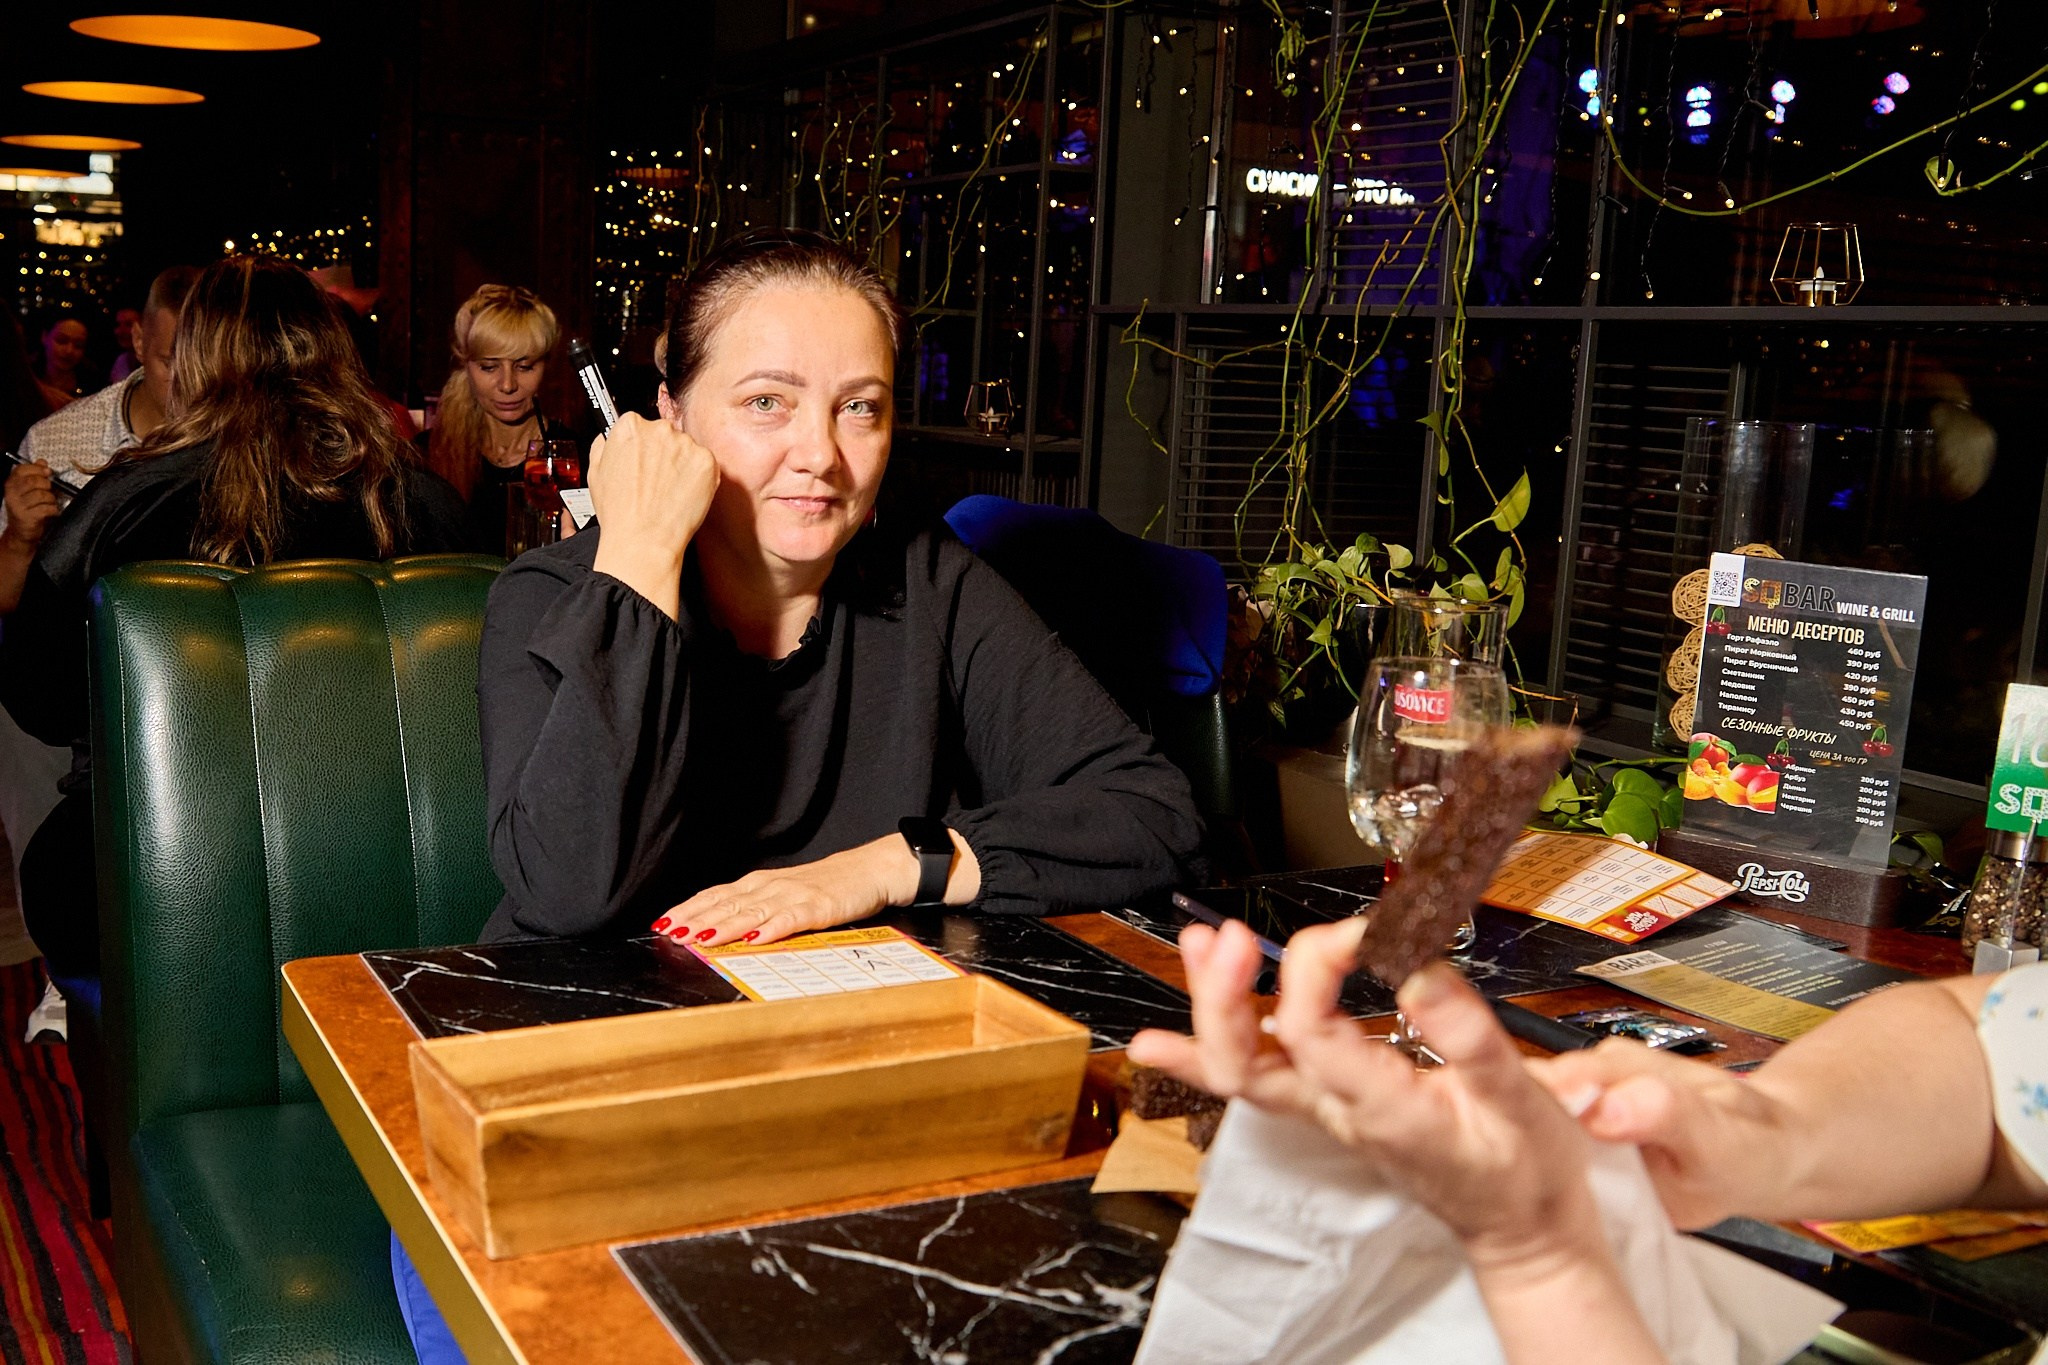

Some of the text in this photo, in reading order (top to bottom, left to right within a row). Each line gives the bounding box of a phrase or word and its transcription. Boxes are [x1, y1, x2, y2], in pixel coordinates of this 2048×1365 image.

[1836, 602, 1869, 617] WINE
[1869, 606, 1880, 619] &
[1881, 607, 1916, 623] GRILL
[1747, 615, 1865, 646] МЕНЮ ДЕСЕРТОВ
[1724, 644, 1797, 661] Пирог Морковный
[1864, 650, 1881, 659] руб
[1723, 656, 1799, 673] Пирог Брусничный
[1846, 659, 1880, 671] 390 руб
[1721, 667, 1765, 680] Сметанник
[1844, 671, 1878, 683] 420 руб
[1720, 679, 1756, 691] Медовик
[1843, 683, 1876, 695] 390 руб
[1719, 690, 1758, 703] Наполеон
[1841, 695, 1875, 707] 450 руб
[1718, 702, 1756, 715] Тирамису
[1840, 707, 1873, 719] 430 руб
[1721, 717, 1837, 745] СЕЗОННЫЕ ФРУКТЫ
[1855, 722, 1872, 731] руб
[1809, 750, 1831, 759] ЦЕНА
[1831, 752, 1842, 761] ЗА
[1856, 757, 1868, 765] ГР
[1860, 776, 1889, 787] 200 руб
[1859, 786, 1873, 794] 200
[1857, 796, 1872, 804] 200
[1856, 806, 1870, 814] 200
[1855, 816, 1869, 824] 300
